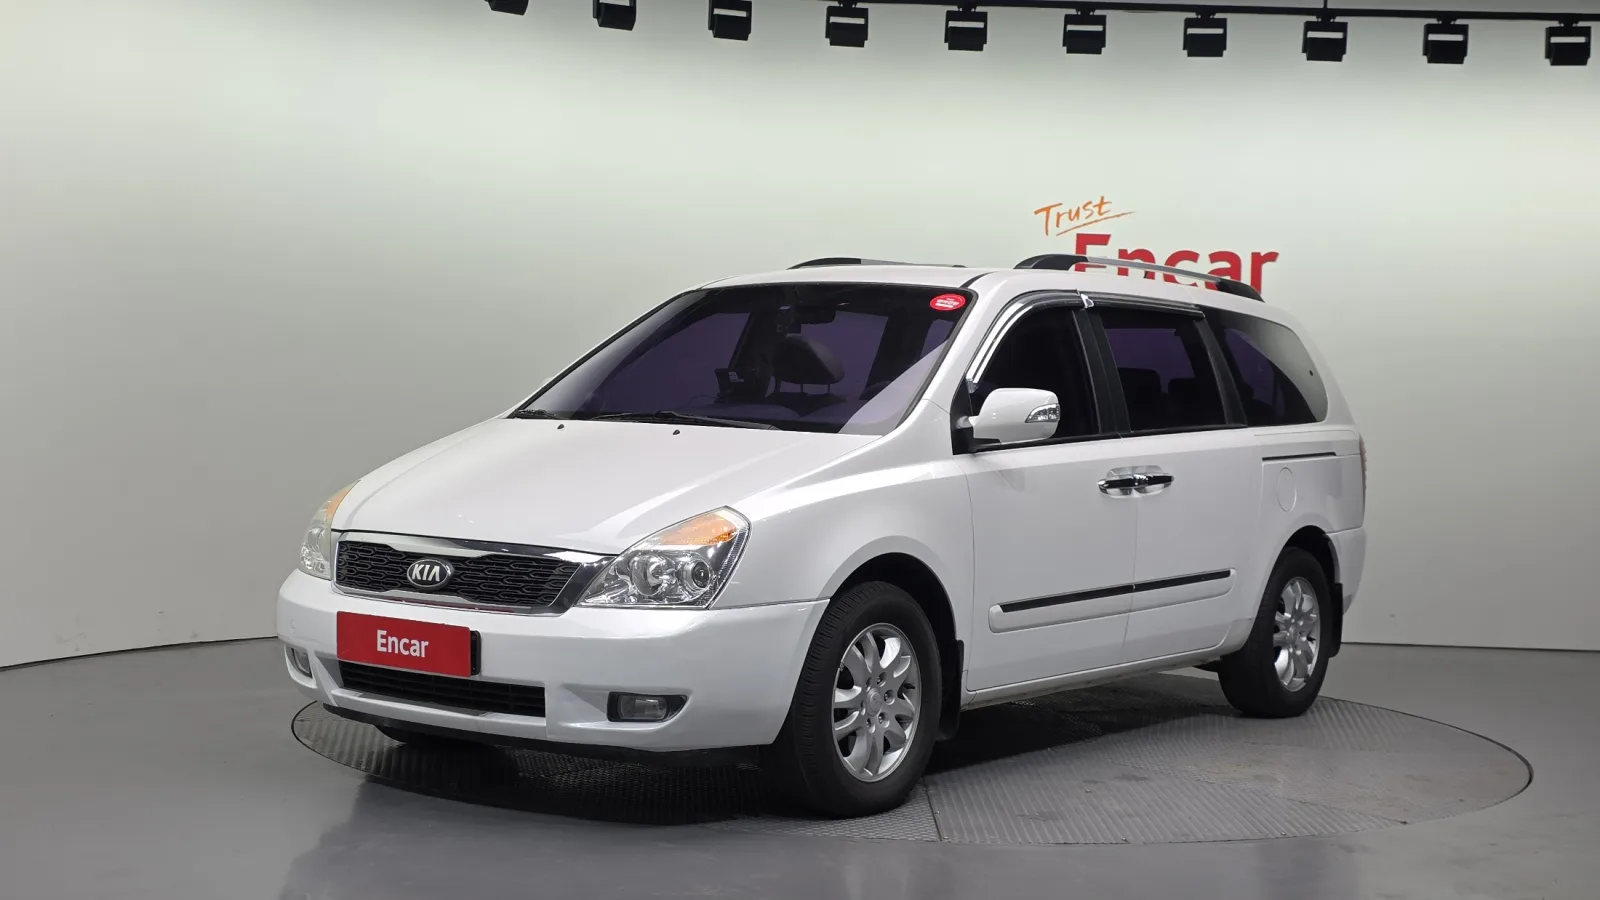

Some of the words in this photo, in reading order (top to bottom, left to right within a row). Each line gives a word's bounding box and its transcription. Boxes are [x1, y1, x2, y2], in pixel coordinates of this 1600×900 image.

[1034, 195, 1114, 236] Trust
[411, 564, 440, 582] KIA
[376, 629, 429, 658] Encar
